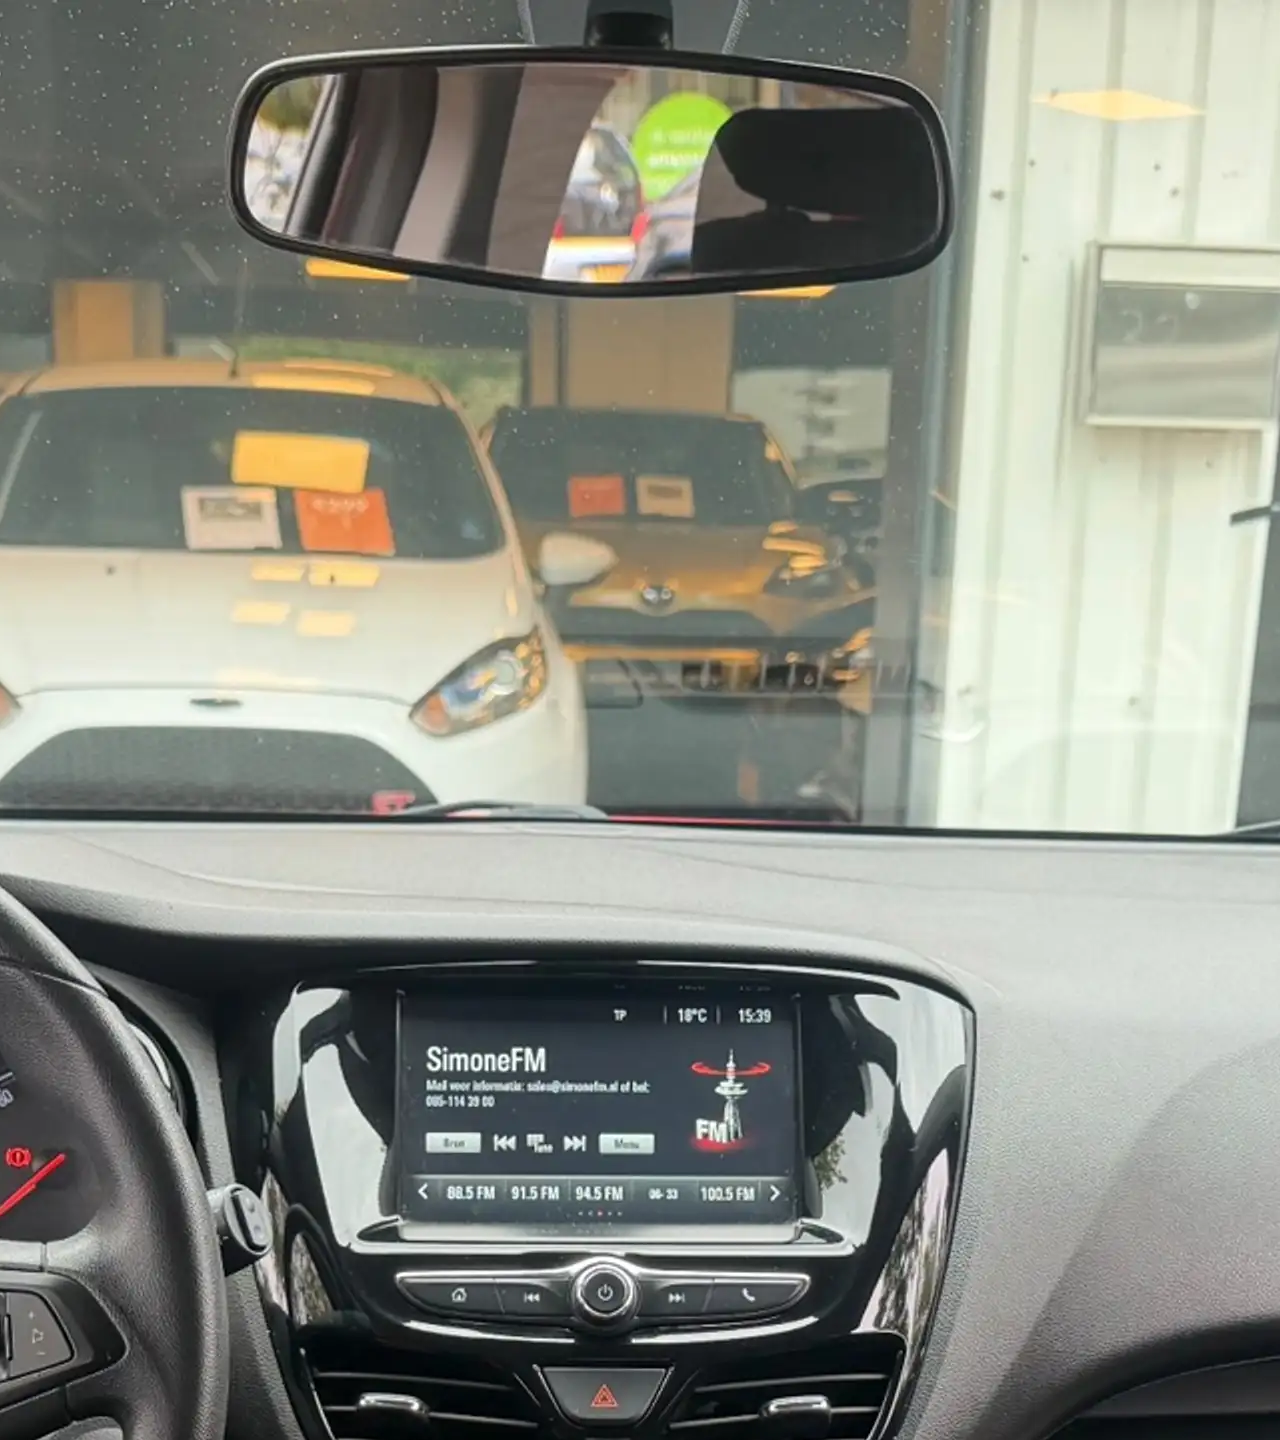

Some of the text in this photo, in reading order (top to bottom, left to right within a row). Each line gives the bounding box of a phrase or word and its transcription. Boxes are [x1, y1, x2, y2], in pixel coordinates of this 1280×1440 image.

[738, 1008, 772, 1024] 15:39
[426, 1046, 546, 1073] SimoneFM
[426, 1080, 448, 1092] Mail
[620, 1080, 631, 1092] of
[696, 1118, 728, 1144] FM
[476, 1186, 496, 1200] FM
[511, 1186, 560, 1200] 91.5 FM
[576, 1186, 624, 1201] 94.5 FM
[736, 1187, 756, 1201] FM
